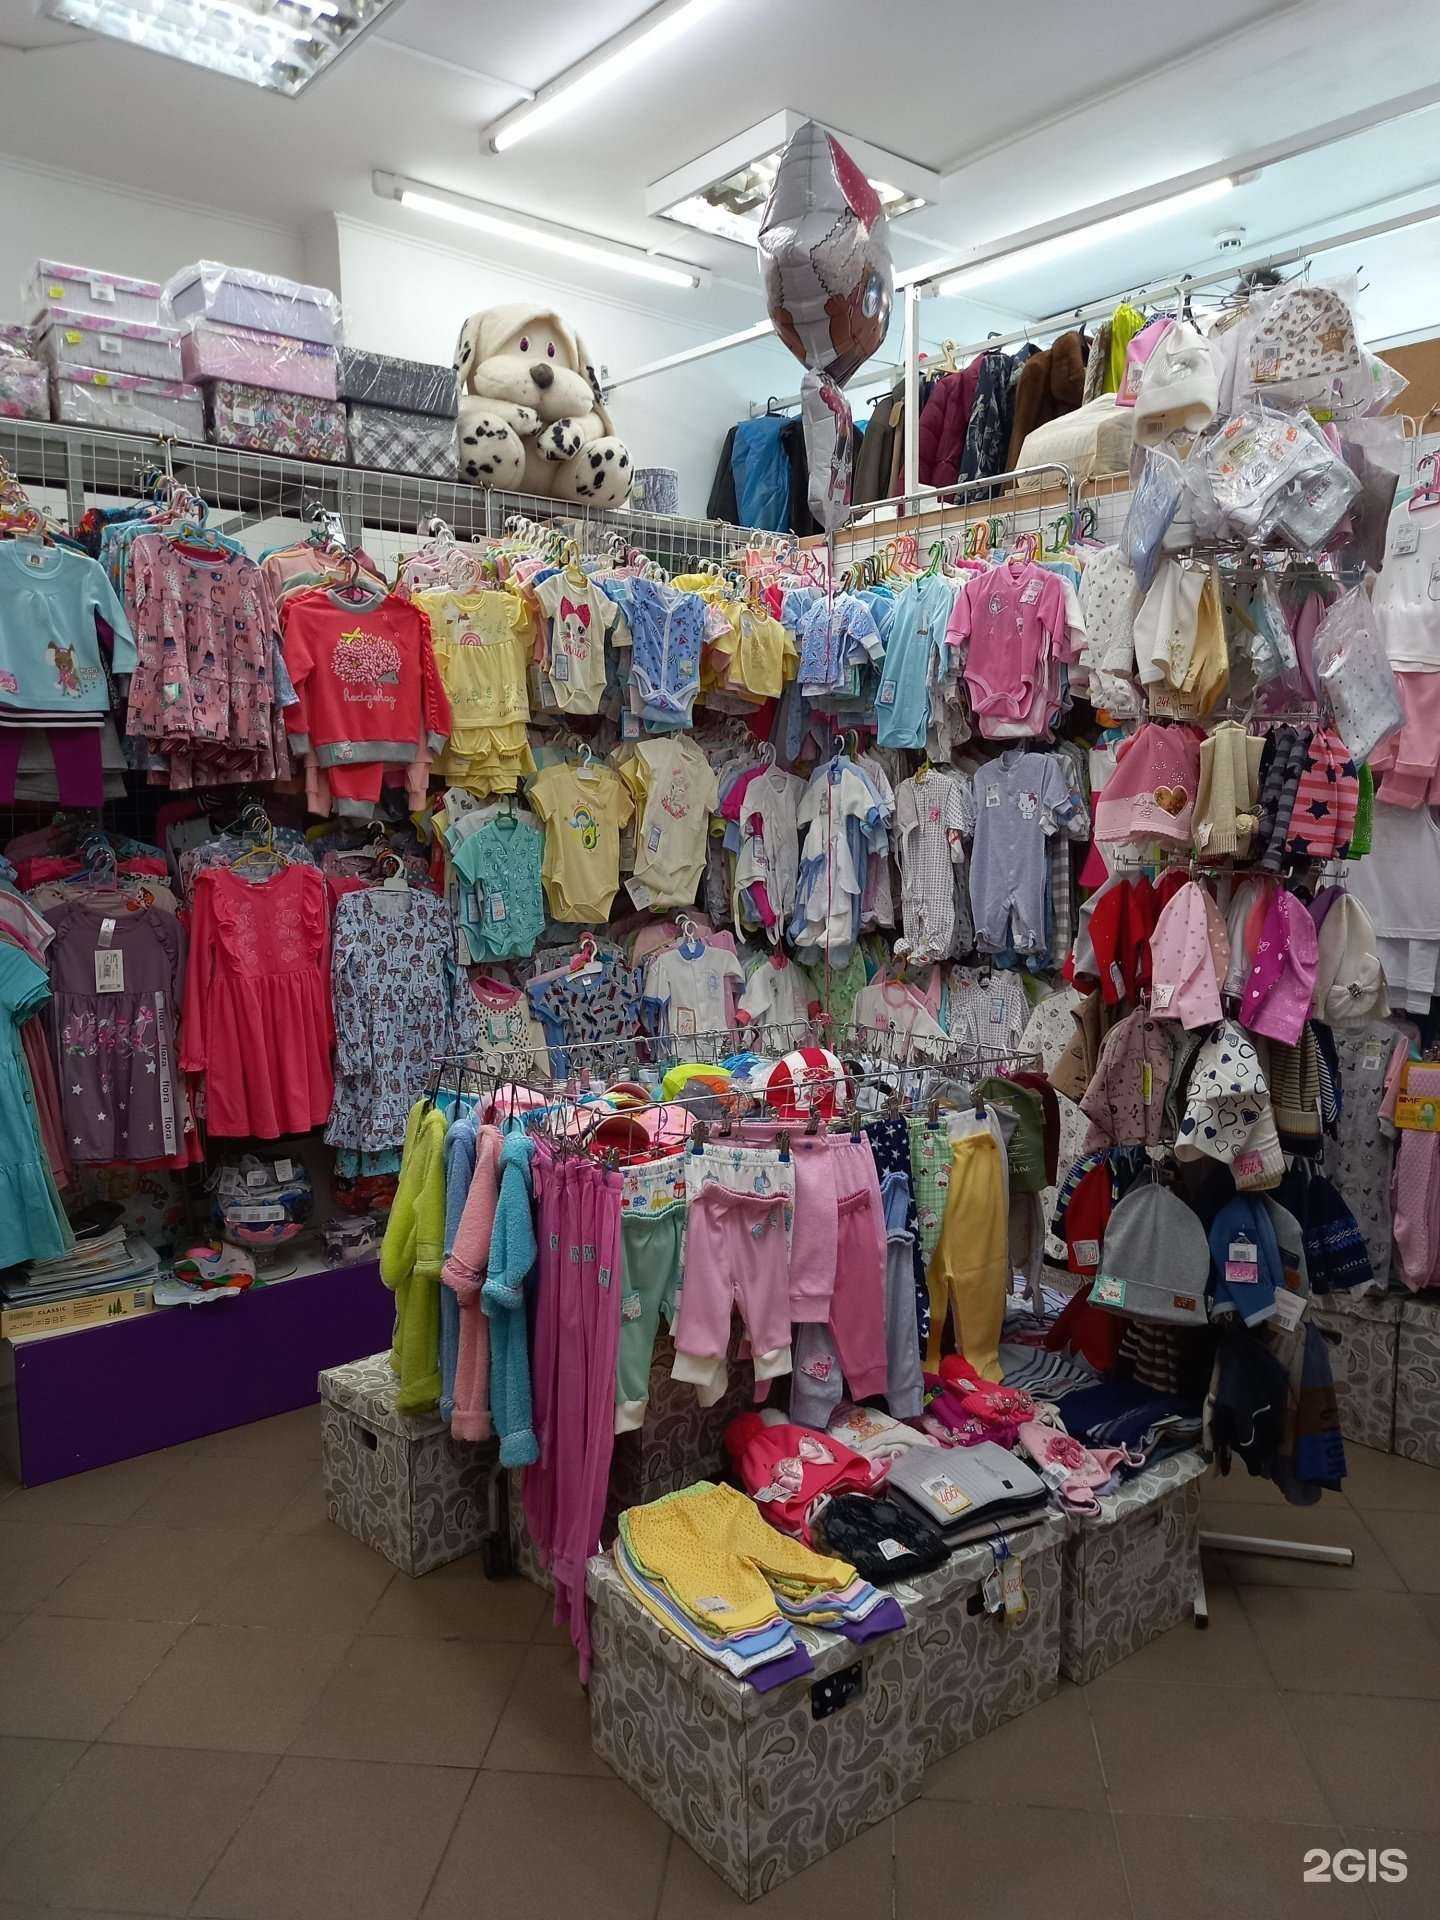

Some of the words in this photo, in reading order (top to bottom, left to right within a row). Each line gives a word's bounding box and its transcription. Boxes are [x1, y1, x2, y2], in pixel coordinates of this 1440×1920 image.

[343, 687, 397, 711] hedgehog
[164, 1116, 173, 1140] flora
[37, 1305, 67, 1316] CLASSIC
